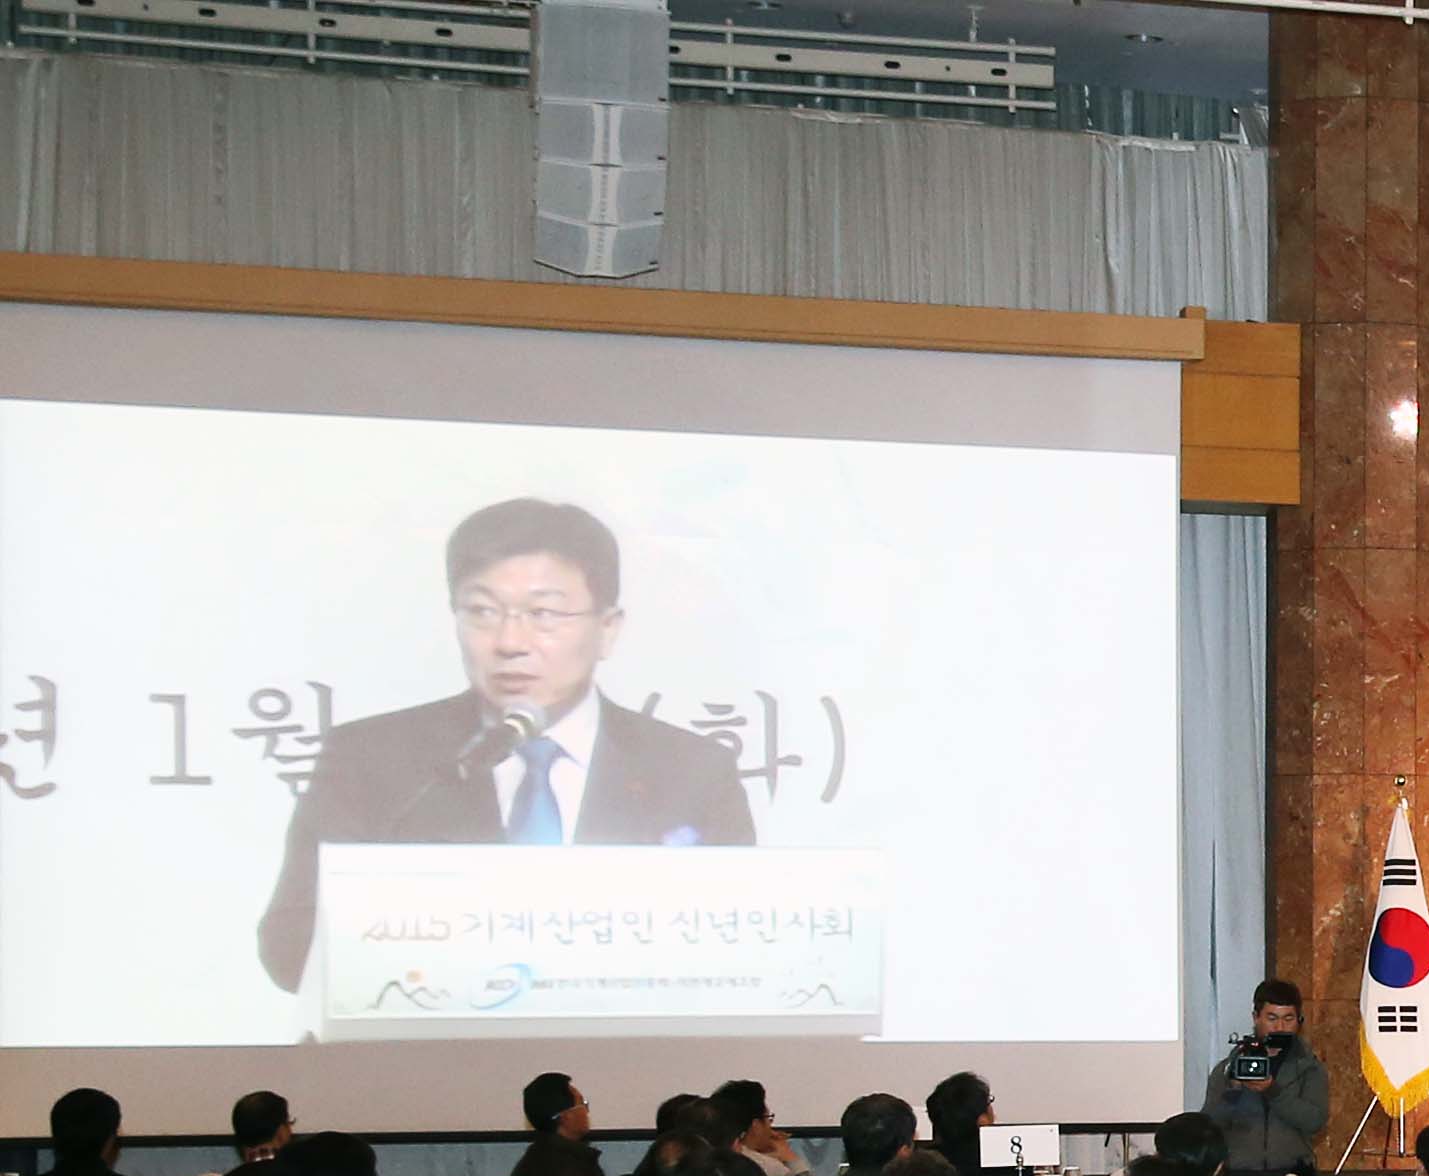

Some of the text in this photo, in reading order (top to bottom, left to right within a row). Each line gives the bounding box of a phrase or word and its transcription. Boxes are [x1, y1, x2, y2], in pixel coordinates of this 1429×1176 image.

[147, 680, 336, 793] 1월
[462, 909, 655, 945] 기계산업인
[667, 906, 855, 945] 신년인사회
[1010, 1135, 1023, 1155] 8
